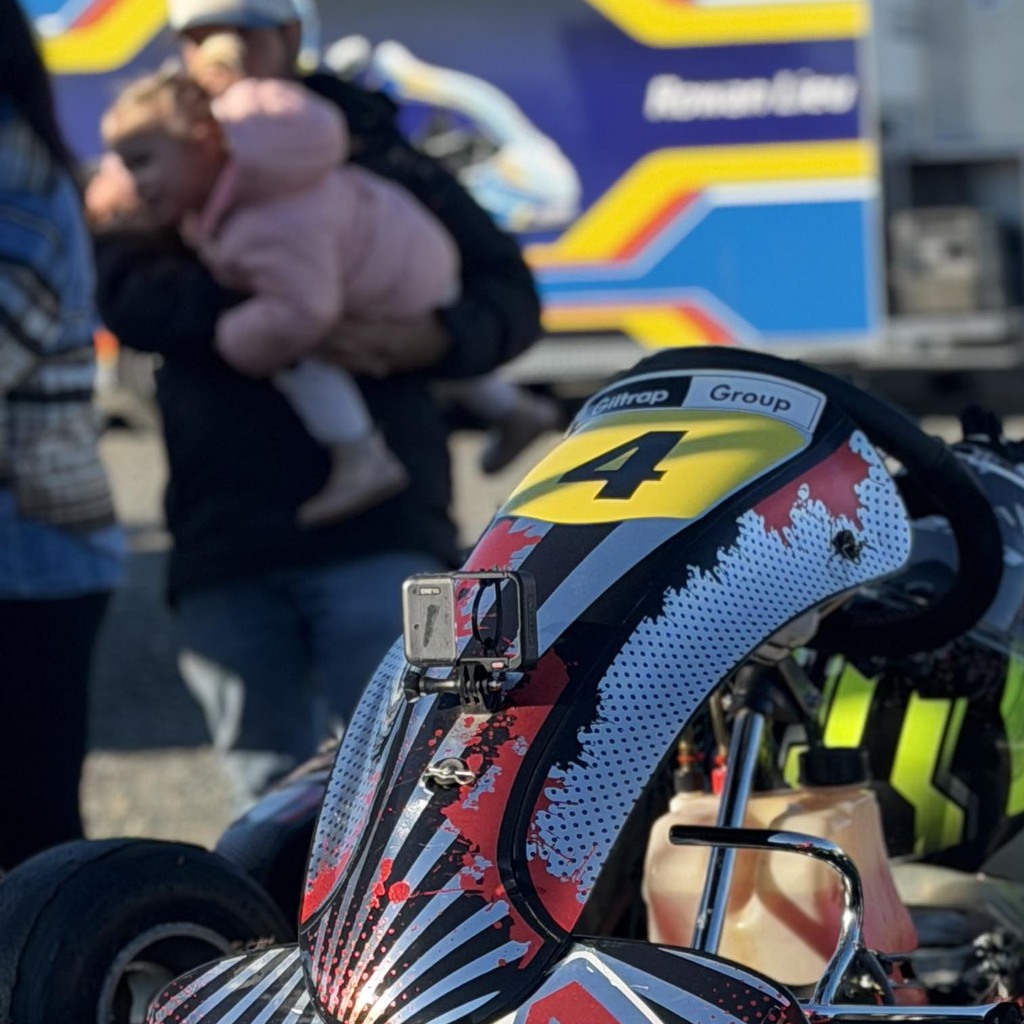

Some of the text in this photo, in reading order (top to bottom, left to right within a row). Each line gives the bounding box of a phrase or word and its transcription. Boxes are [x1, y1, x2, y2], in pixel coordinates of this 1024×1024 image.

[591, 384, 792, 416] Giltrap Group
[557, 430, 690, 501] 4
